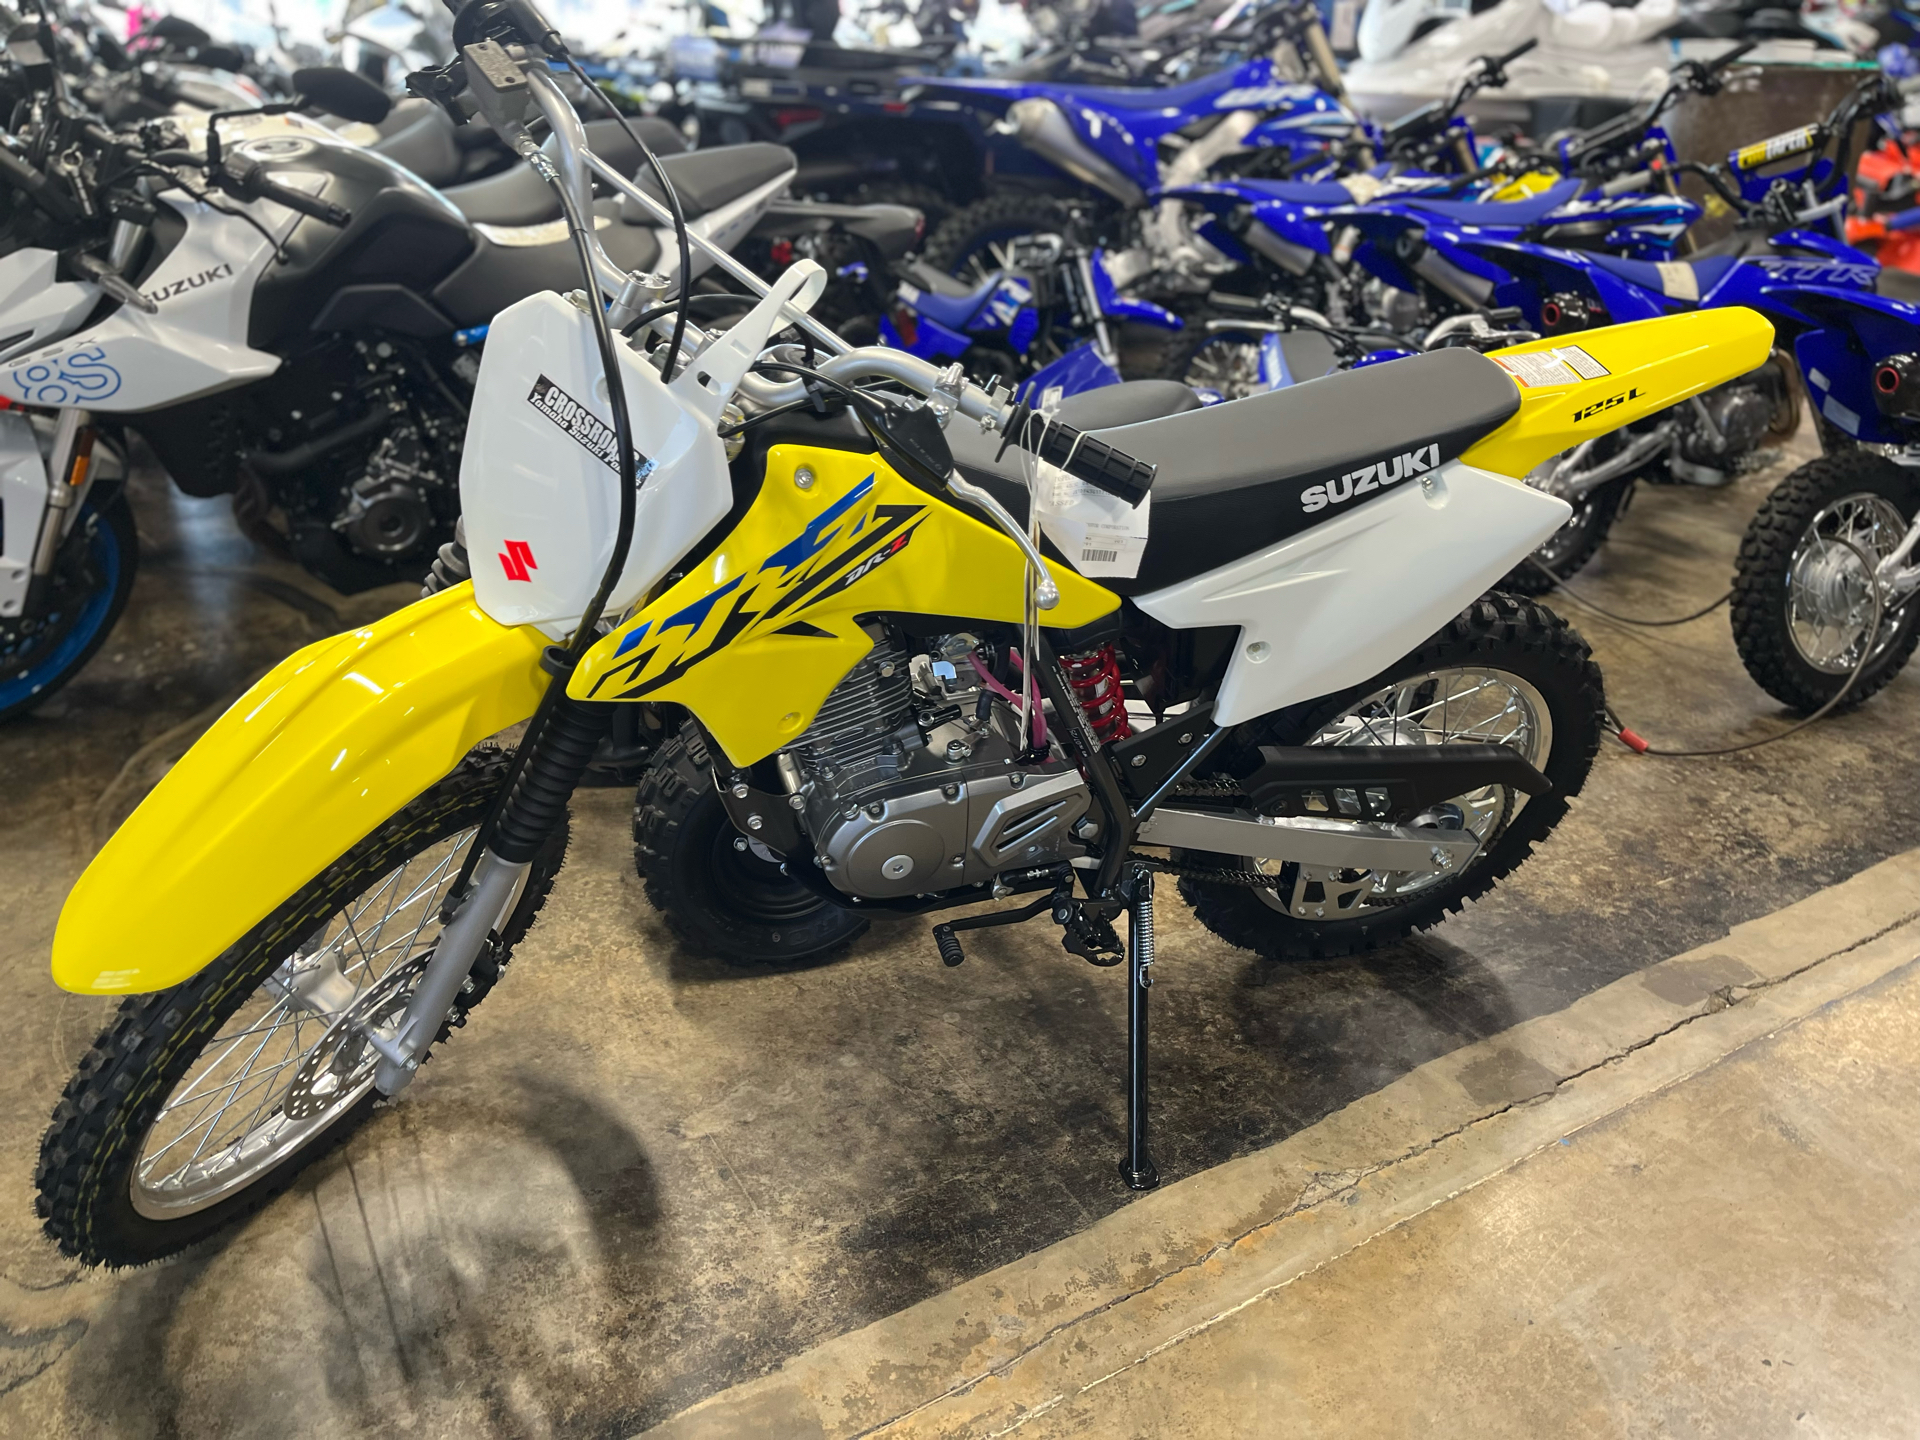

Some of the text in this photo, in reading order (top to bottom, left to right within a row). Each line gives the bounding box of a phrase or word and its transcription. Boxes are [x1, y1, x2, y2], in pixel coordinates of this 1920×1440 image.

[529, 391, 606, 457] Yamaha Suzuki
[1300, 443, 1440, 513] SUZUKI
[845, 534, 908, 586] DR-Z
